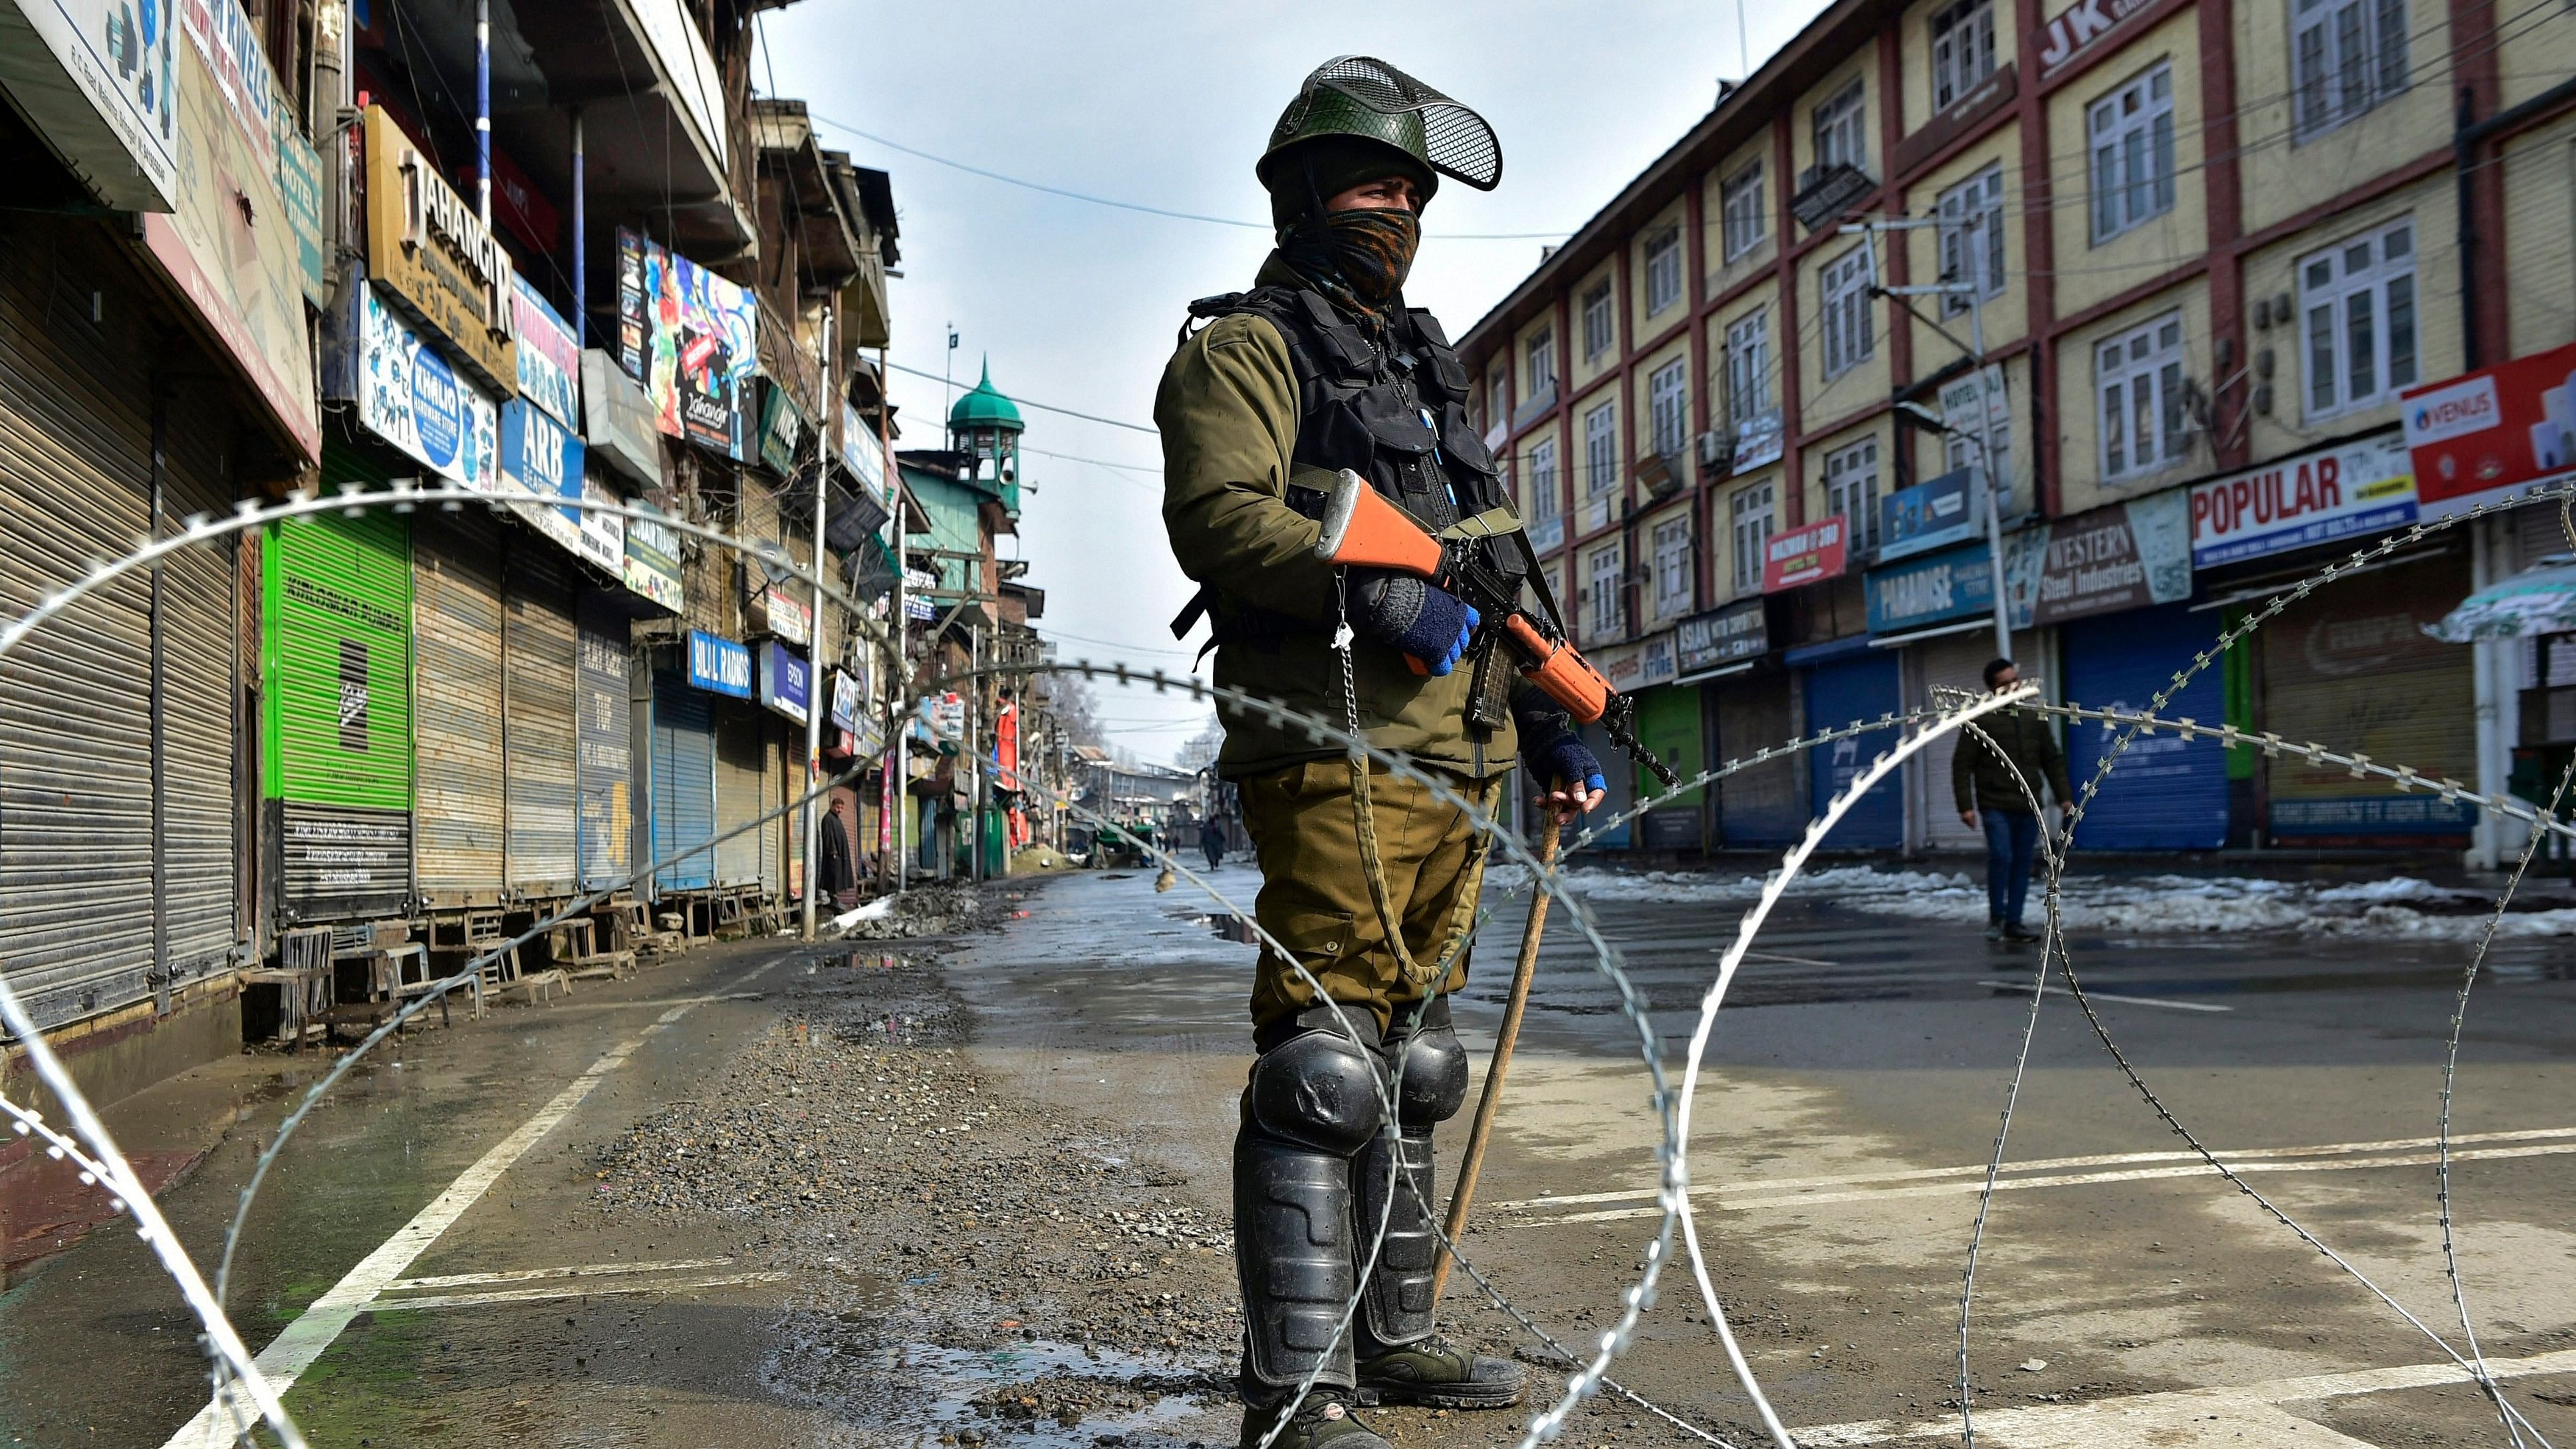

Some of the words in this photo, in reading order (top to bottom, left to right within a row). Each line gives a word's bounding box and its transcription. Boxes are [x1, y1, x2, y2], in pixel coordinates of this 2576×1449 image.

[398, 148, 513, 341] JAHANGIR
[2430, 392, 2491, 424] VENUS
[522, 404, 564, 488] ARB
[2193, 456, 2341, 540] POPULAR
[2049, 523, 2130, 571] WESTERN
[1880, 564, 1954, 621] PARADISE
[2041, 571, 2073, 601] Steel
[2074, 557, 2143, 594] Industries
[1678, 619, 1712, 654] ASIAN
[694, 638, 718, 682] BILAL
[720, 646, 749, 689] RADIOS
[787, 662, 804, 689] EPSON
